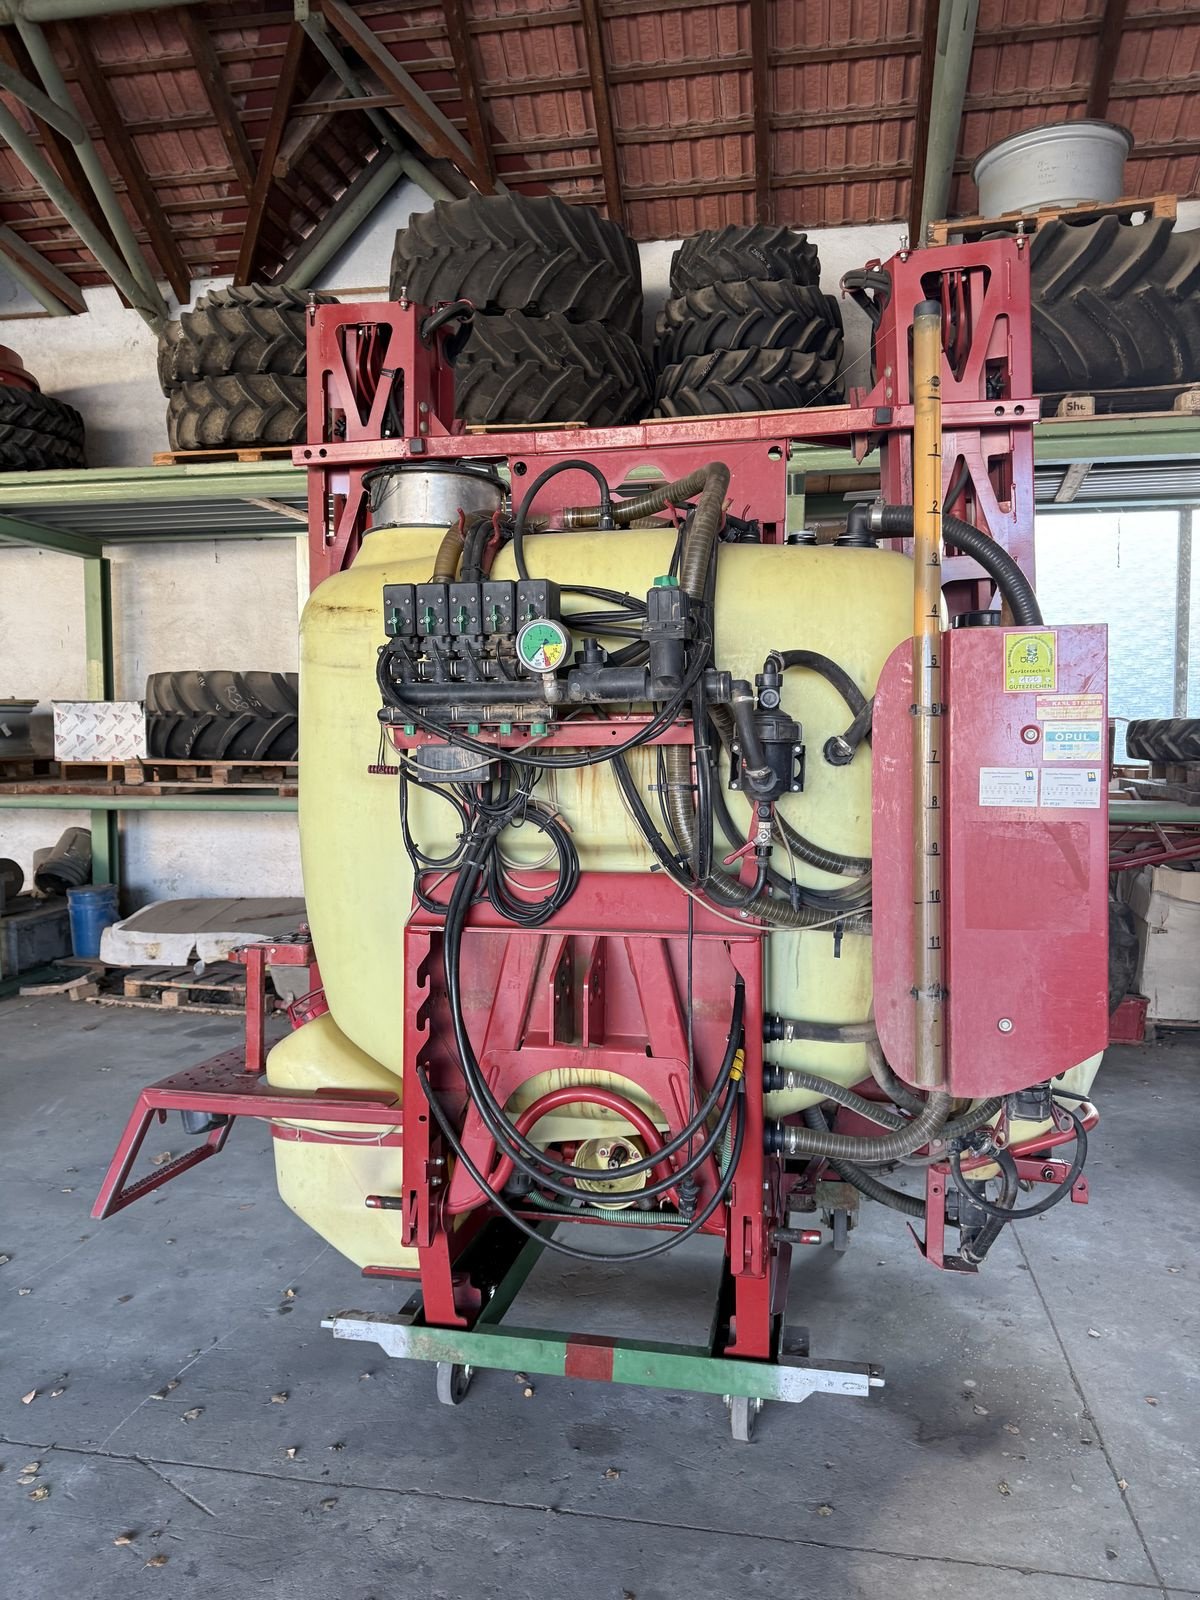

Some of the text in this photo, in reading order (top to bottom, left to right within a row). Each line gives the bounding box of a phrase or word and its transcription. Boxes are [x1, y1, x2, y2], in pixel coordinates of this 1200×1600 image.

[932, 500, 938, 512] 2
[931, 552, 938, 564] 3
[931, 603, 937, 615] 4
[931, 655, 937, 666] 5
[931, 703, 937, 714] 6
[931, 750, 937, 761] 7
[931, 796, 938, 806] 8
[932, 842, 938, 853] 9
[929, 889, 940, 900] 10
[929, 936, 940, 947] 11
